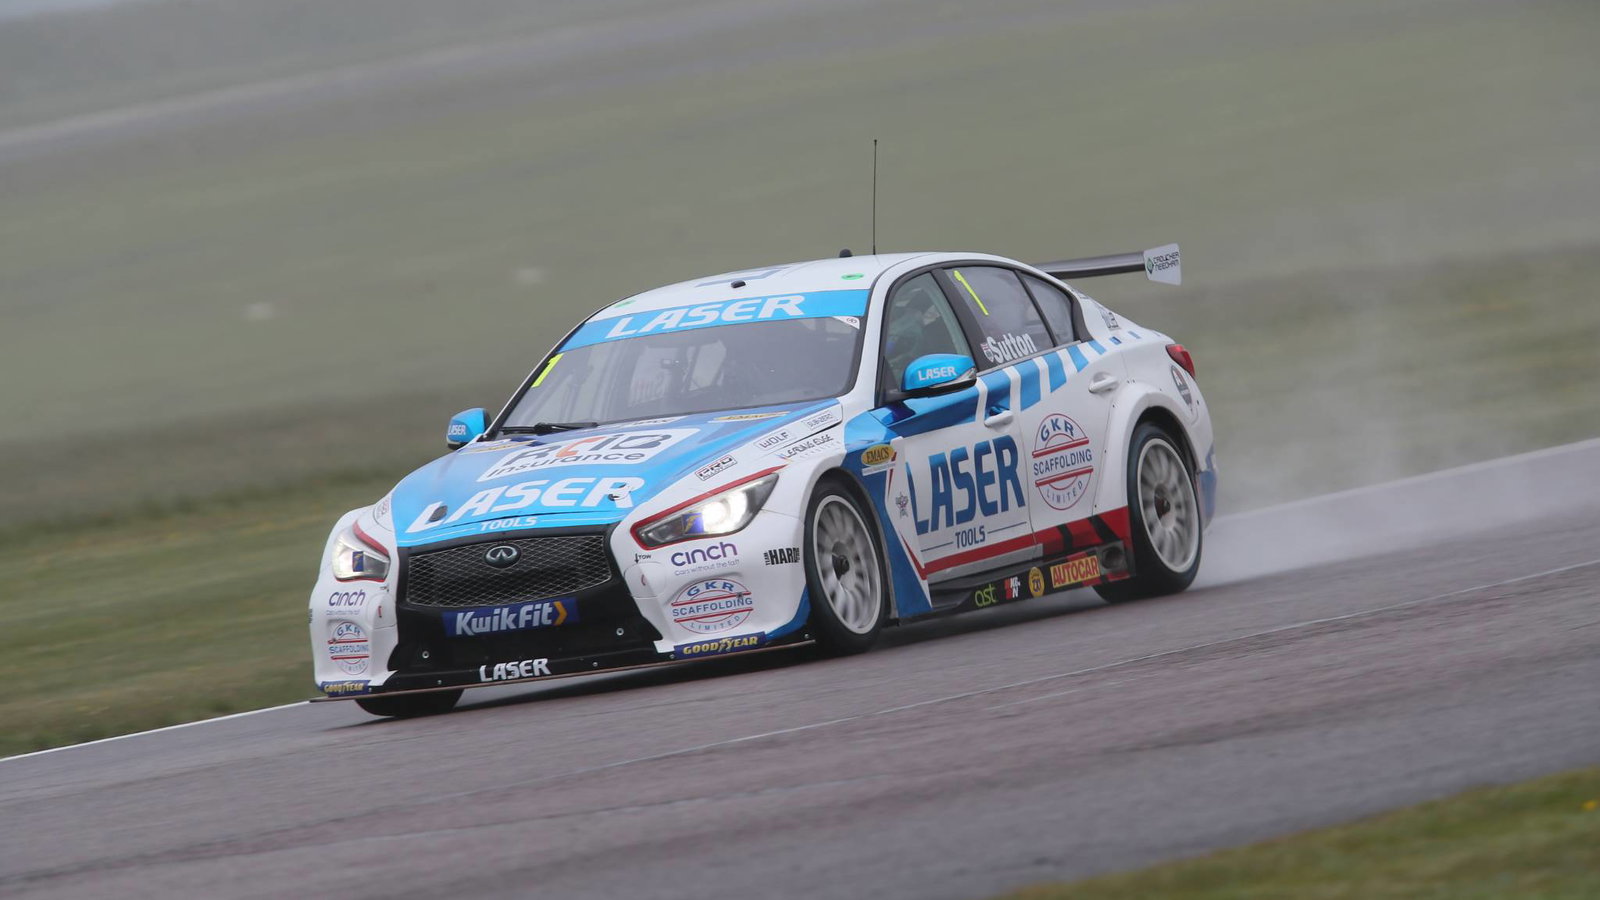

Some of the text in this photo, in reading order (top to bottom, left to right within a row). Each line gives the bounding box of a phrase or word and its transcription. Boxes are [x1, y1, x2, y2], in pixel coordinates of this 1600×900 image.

[953, 270, 989, 316] 1
[605, 294, 805, 339] LASER
[986, 333, 1037, 363] Sutton
[531, 353, 563, 388] 1
[917, 366, 957, 381] LASER
[447, 424, 466, 436] LASER
[759, 431, 789, 448] WOLF
[1040, 417, 1075, 442] GKR
[1033, 449, 1093, 475] SCAFFOLDING
[905, 434, 1026, 536] LASER
[1046, 480, 1084, 504] LIMITED
[405, 477, 645, 533] LASER
[480, 517, 538, 531] TOOLS
[955, 525, 986, 548] TOOLS
[671, 542, 738, 566] cinch
[1053, 557, 1099, 586] AUTOCAR
[328, 589, 366, 607] cinch
[687, 581, 734, 597] GKR
[673, 597, 753, 617] SCAFFOLDING
[337, 624, 361, 637] GKR
[690, 615, 741, 631] LIMITED
[329, 644, 369, 654] SCAFFOLDING
[683, 636, 758, 655] GOODYEAR
[479, 658, 551, 682] LASER
[324, 682, 364, 694] GOODYEAR
